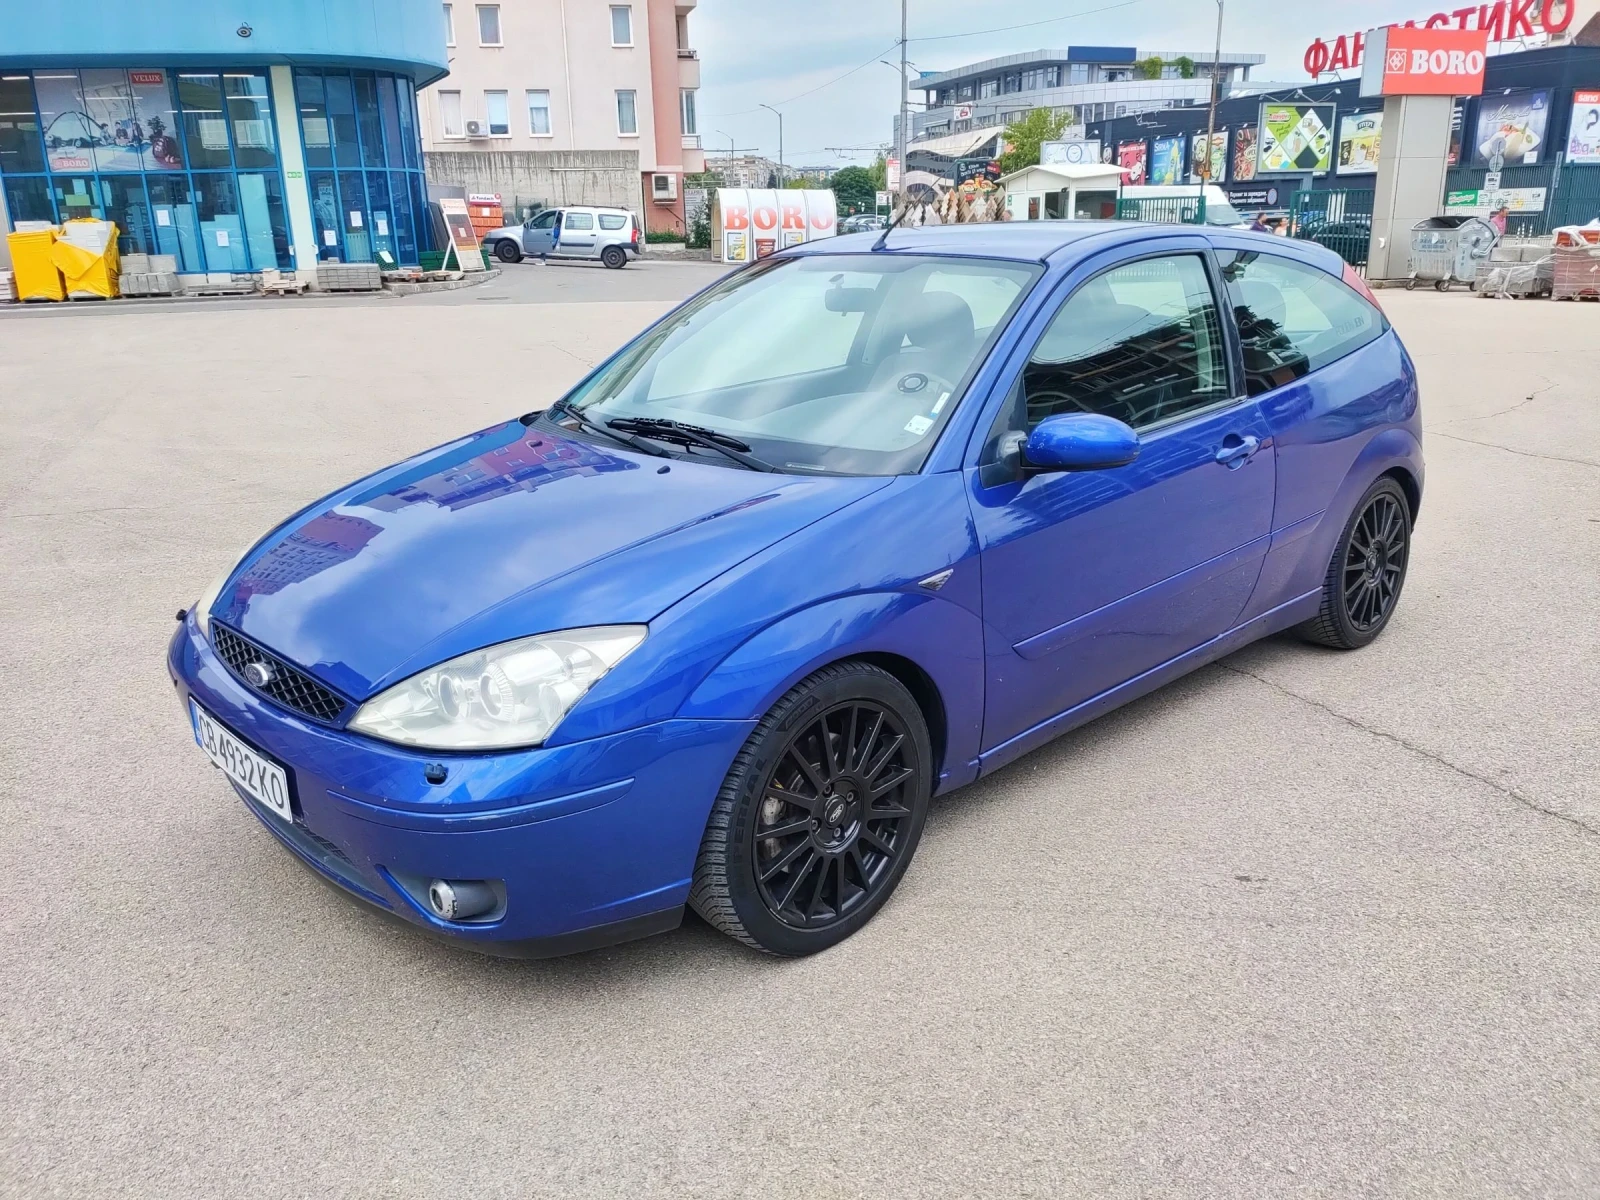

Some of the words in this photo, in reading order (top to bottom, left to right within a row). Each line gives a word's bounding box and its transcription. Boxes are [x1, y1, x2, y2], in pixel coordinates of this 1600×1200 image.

[1303, 0, 1575, 78] ФАНТИКО
[1409, 49, 1484, 75] BORO
[133, 74, 161, 82] VELUX
[1578, 94, 1599, 103] sano
[62, 159, 89, 167] BORO
[725, 205, 834, 230] BORO
